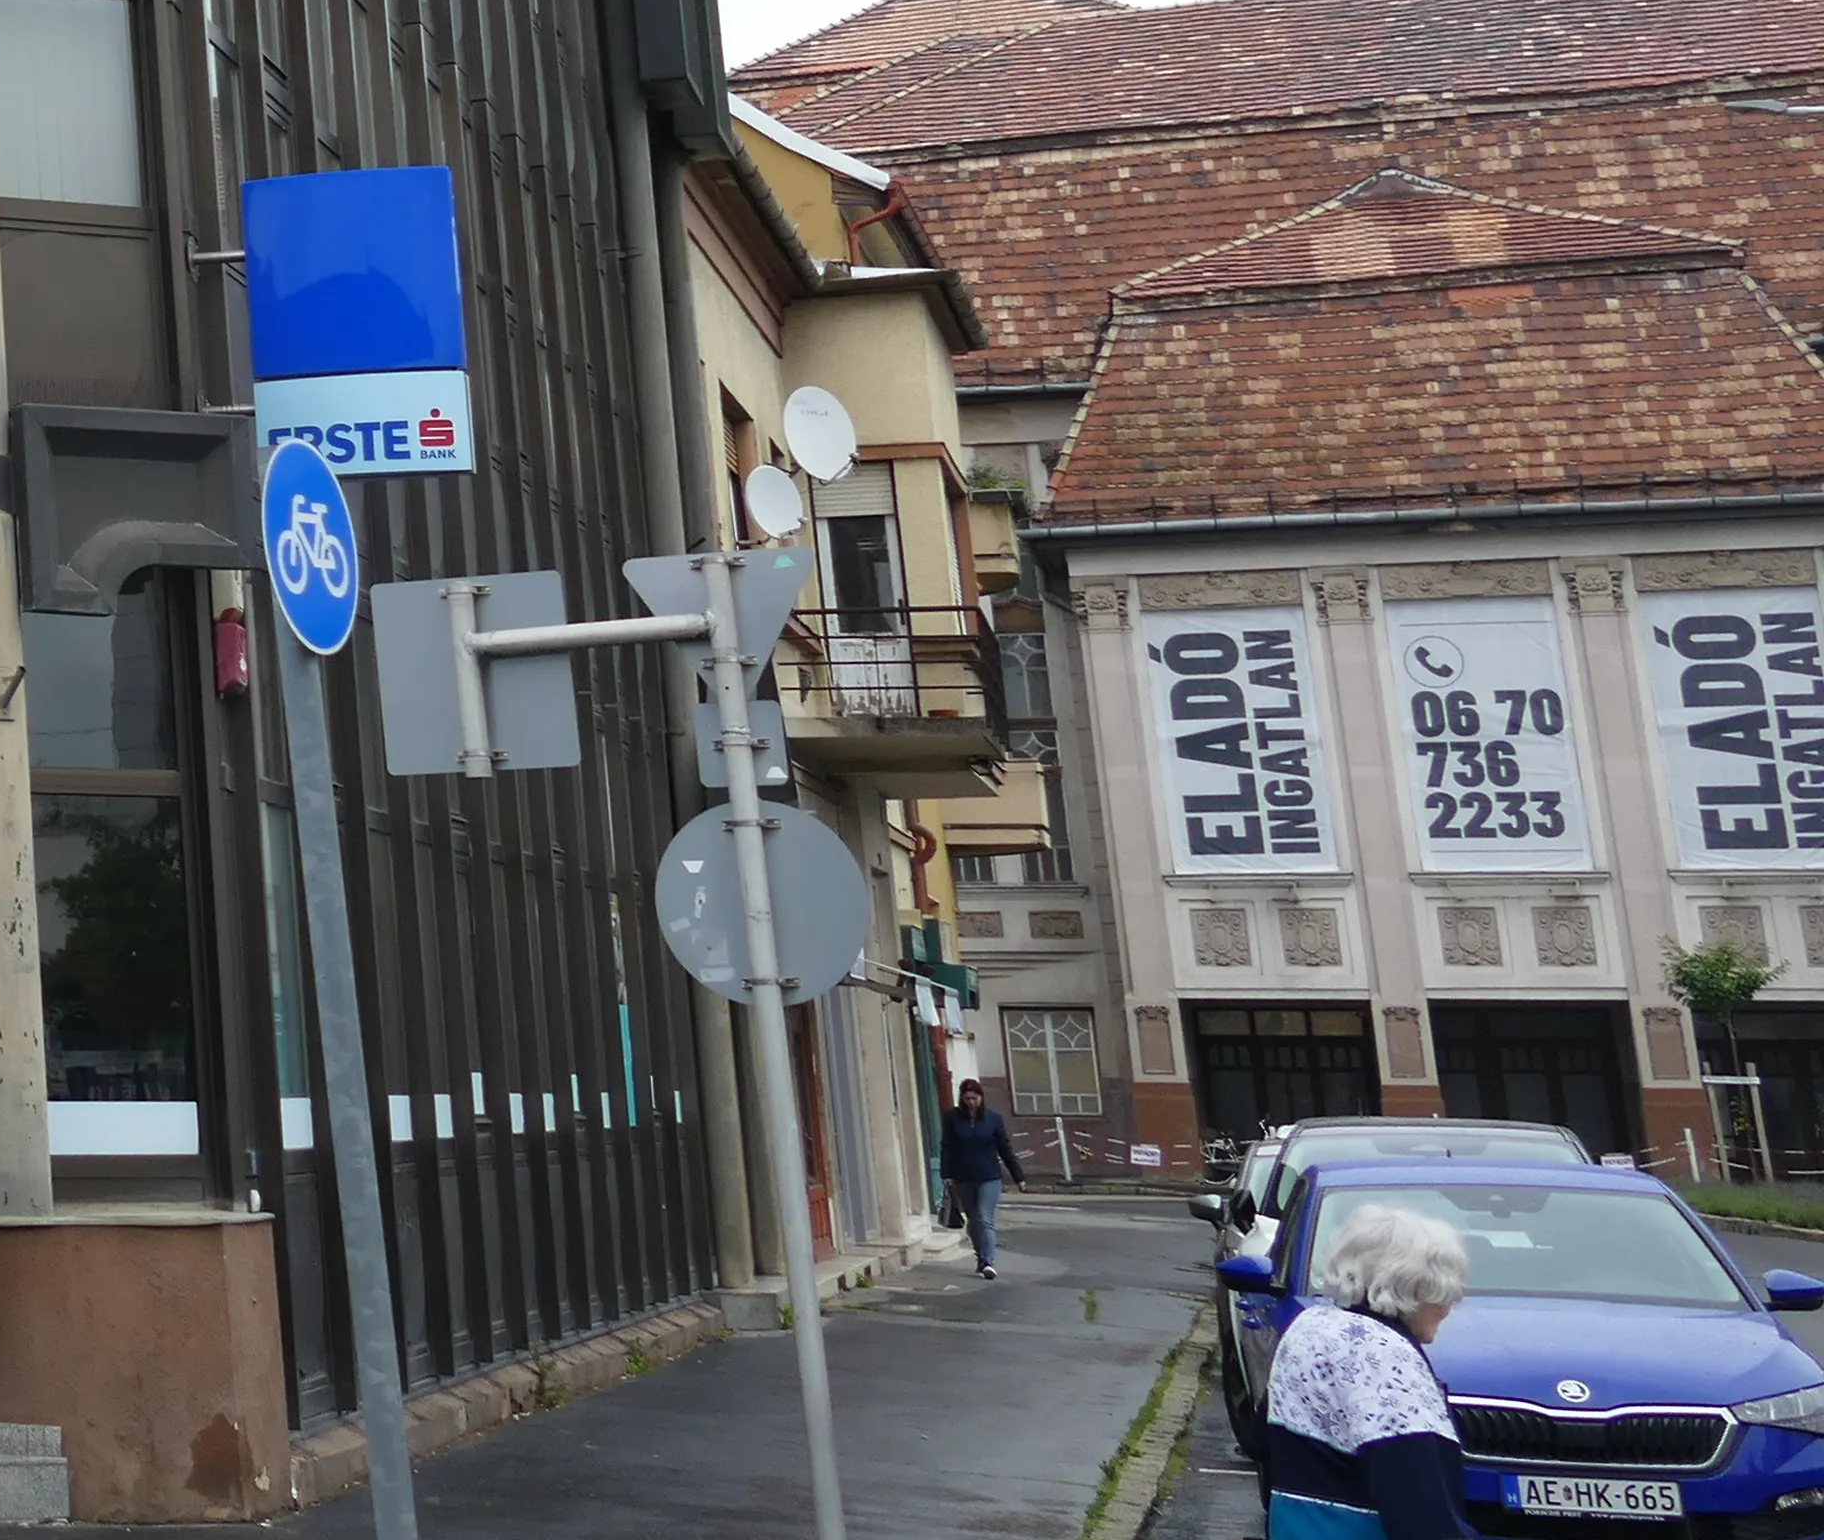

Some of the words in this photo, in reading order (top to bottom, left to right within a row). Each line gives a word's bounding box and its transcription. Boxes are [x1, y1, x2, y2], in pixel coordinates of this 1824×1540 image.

[420, 449, 457, 460] BANK
[1411, 689, 1480, 738] 06
[1495, 688, 1564, 736] 70
[1654, 613, 1789, 851] ELADÓ
[1147, 630, 1266, 857] ELADÓ
[1243, 628, 1322, 854] INGATLAN
[1416, 740, 1520, 788] 736
[1424, 791, 1567, 840] 2233
[1526, 1480, 1561, 1506] AE
[1575, 1482, 1675, 1511] HK-665
